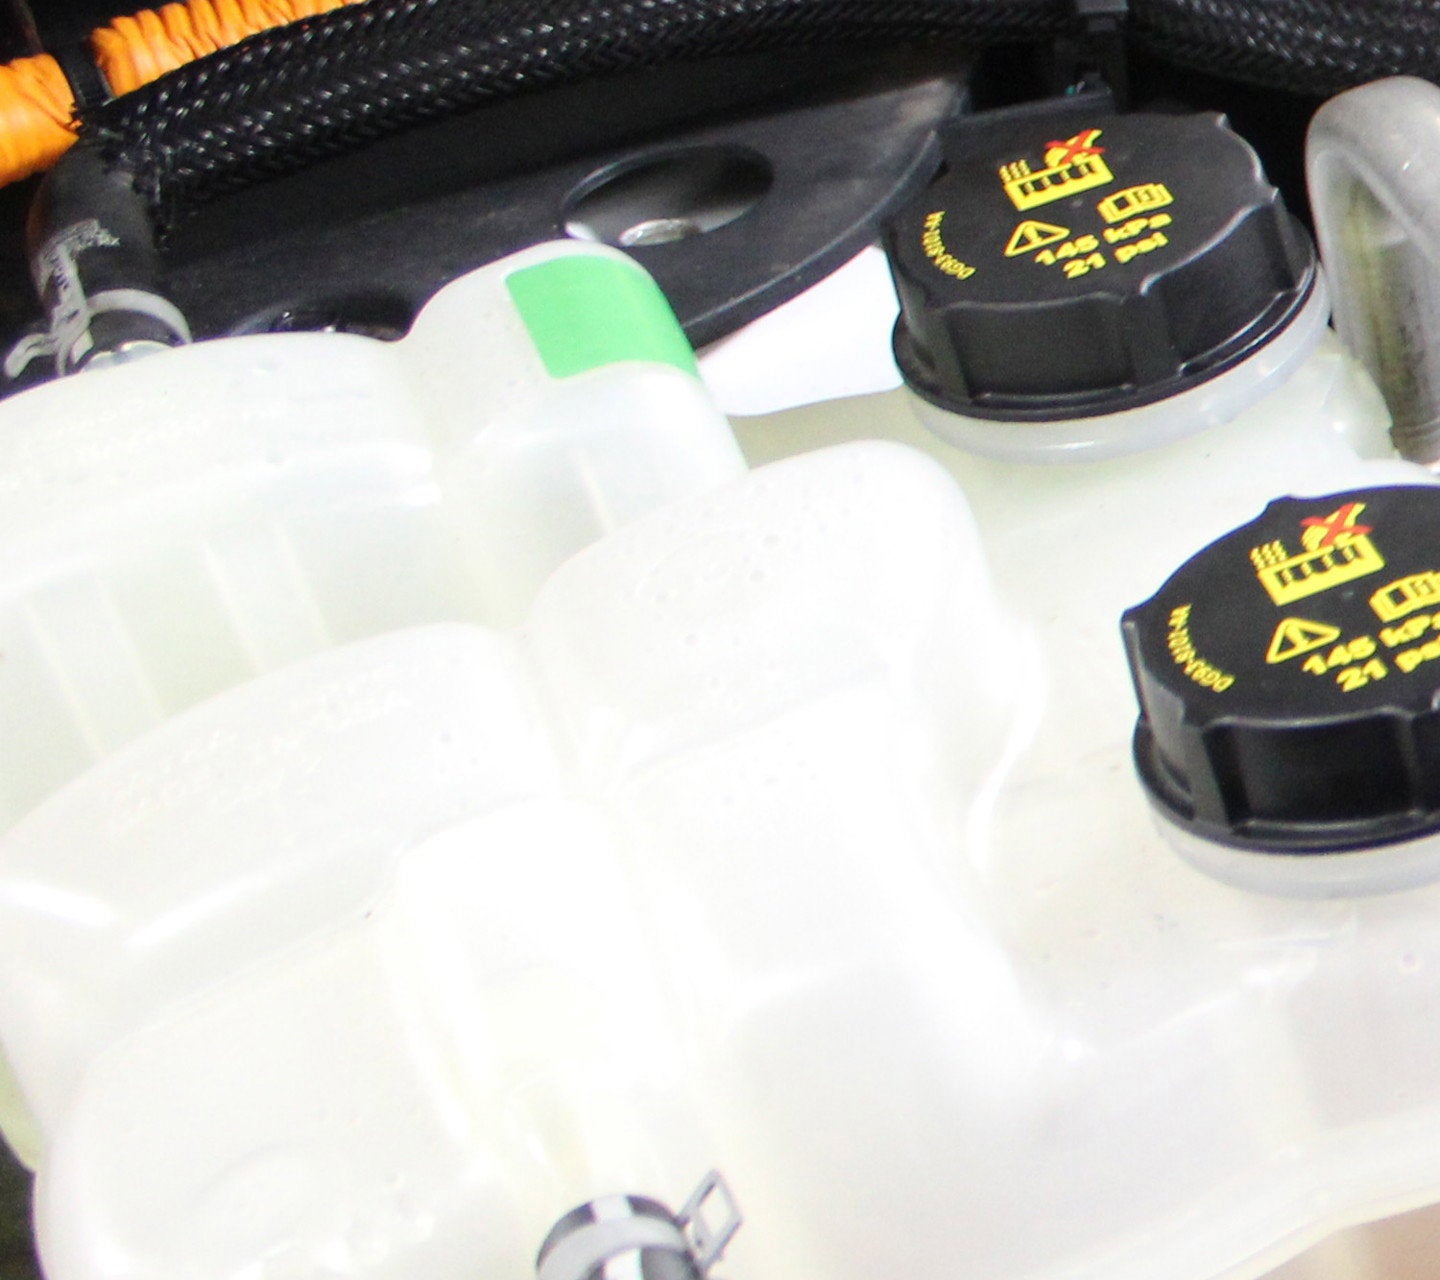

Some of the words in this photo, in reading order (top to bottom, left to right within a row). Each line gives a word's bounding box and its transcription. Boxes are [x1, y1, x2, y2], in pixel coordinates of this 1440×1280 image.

[1034, 234, 1100, 266] 145
[1062, 252, 1107, 279] 21
[1114, 231, 1169, 264] psi
[1302, 635, 1378, 676] 145
[1335, 657, 1388, 693] 21
